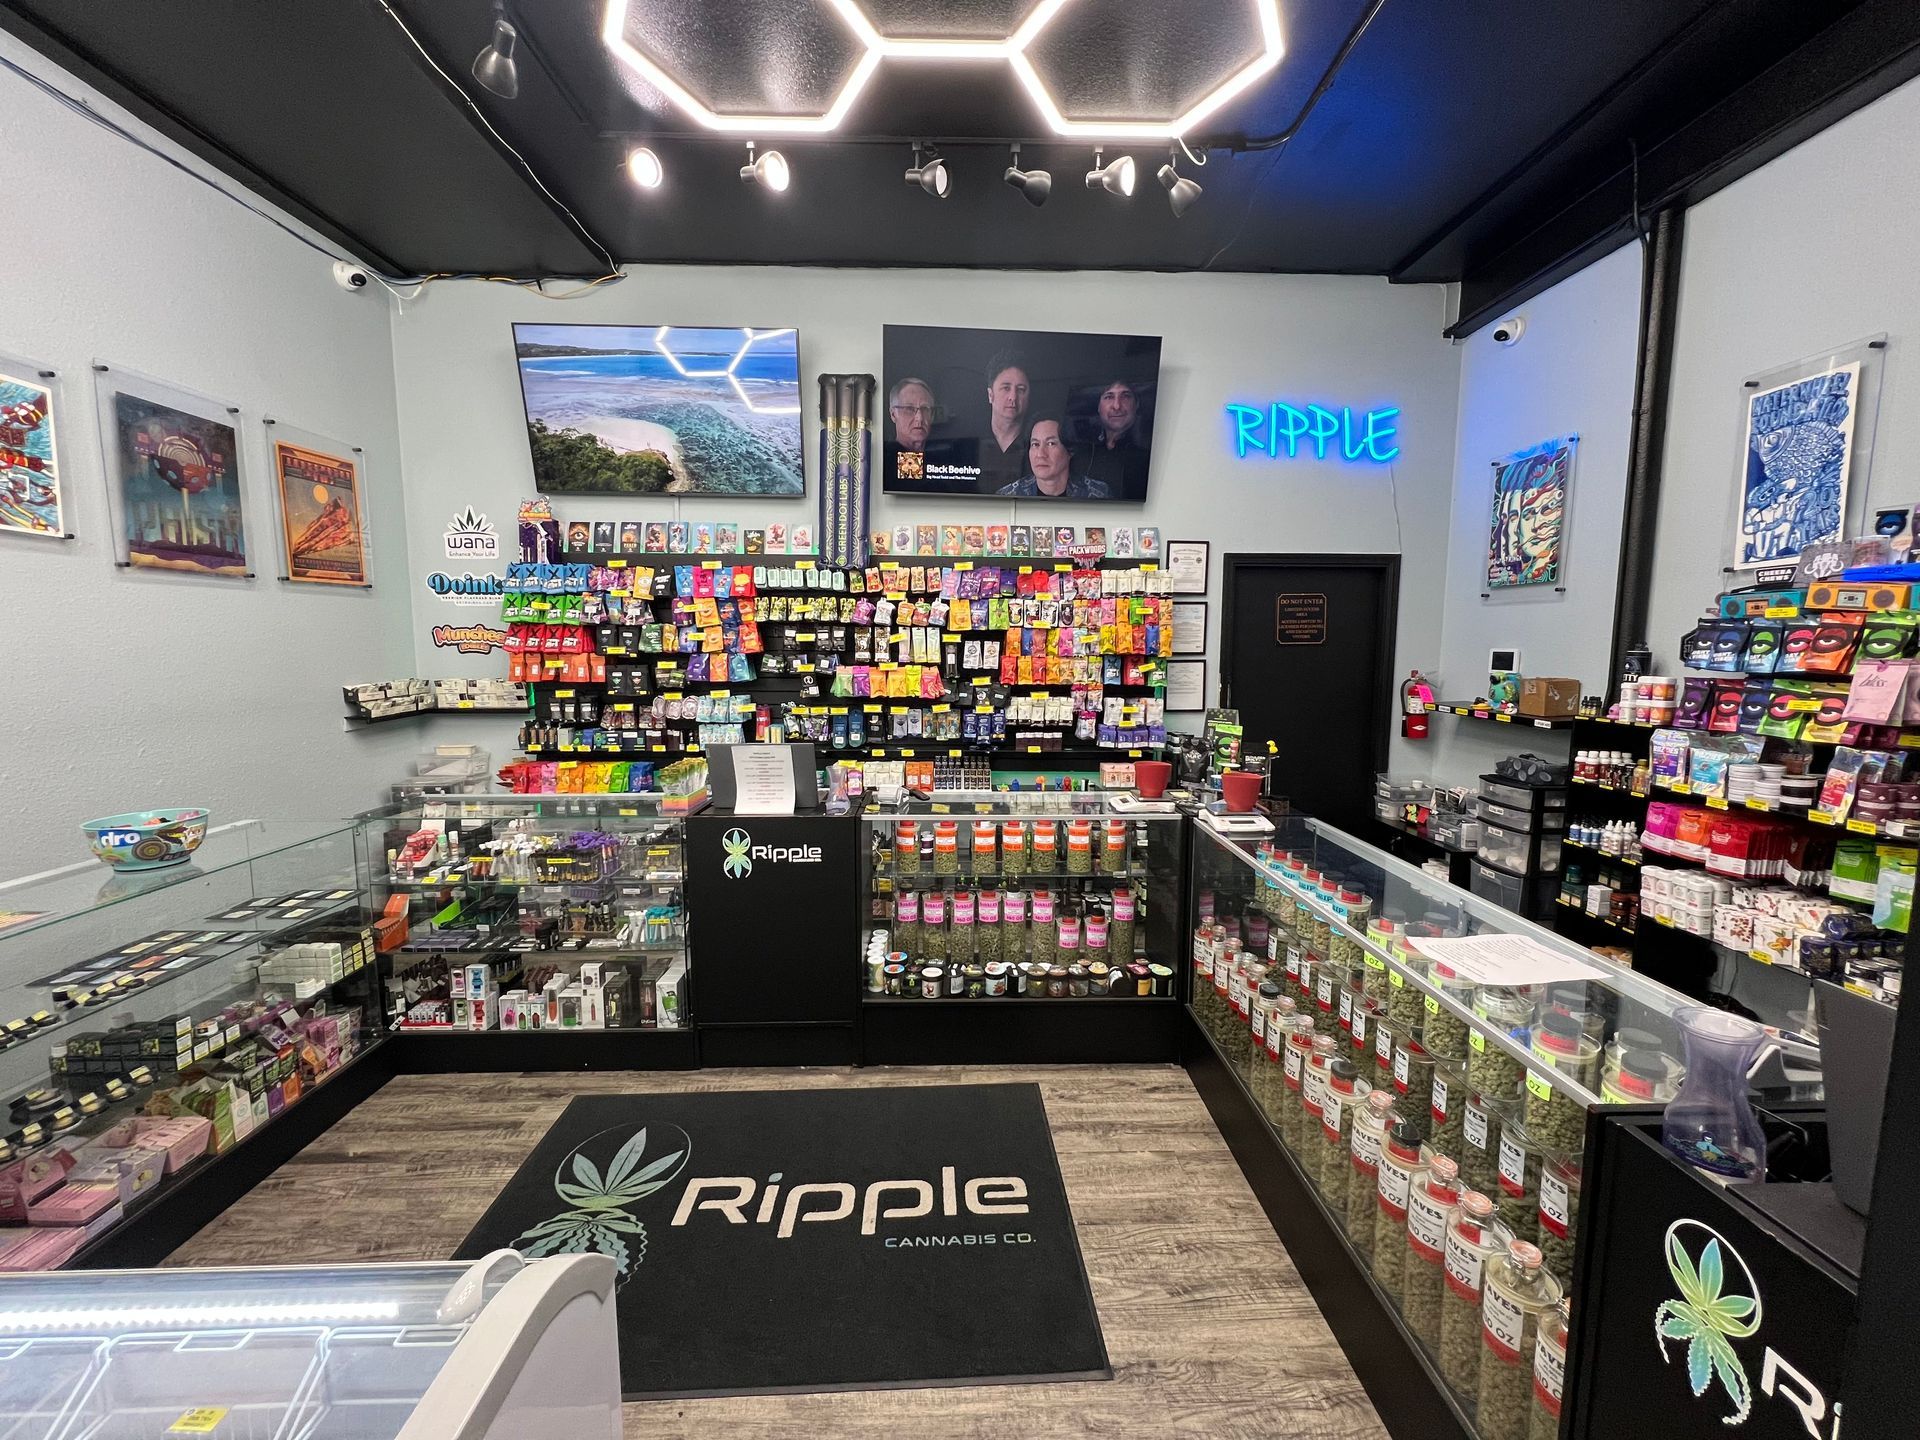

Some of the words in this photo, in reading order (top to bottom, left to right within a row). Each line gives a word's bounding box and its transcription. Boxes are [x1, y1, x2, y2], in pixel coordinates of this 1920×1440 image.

[1226, 403, 1399, 461] RIPPLE
[926, 464, 948, 474] Black
[949, 465, 981, 475] Beehive
[839, 478, 849, 500] LABS
[838, 502, 849, 519] DOT
[447, 537, 496, 549] wana
[838, 520, 847, 553] GREEN
[1069, 545, 1106, 555] PACKWOODS
[1758, 569, 1793, 577] CHEEBA
[1758, 575, 1791, 583] CHEWS
[427, 573, 504, 595] Doink
[434, 626, 507, 644] Munchee
[752, 844, 822, 863] Ripple
[1529, 1079, 1541, 1094] OZ
[1364, 1156, 1378, 1167] OZ
[671, 1166, 1030, 1239] Ripple
[1388, 1193, 1402, 1206] OZ
[1548, 1207, 1563, 1221] OZ
[885, 1233, 997, 1249] CANNABIS
[1003, 1232, 1037, 1244] CO.
[1422, 1234, 1439, 1247] OZ
[1455, 1271, 1472, 1286] OZ
[1496, 1328, 1514, 1346] OZ
